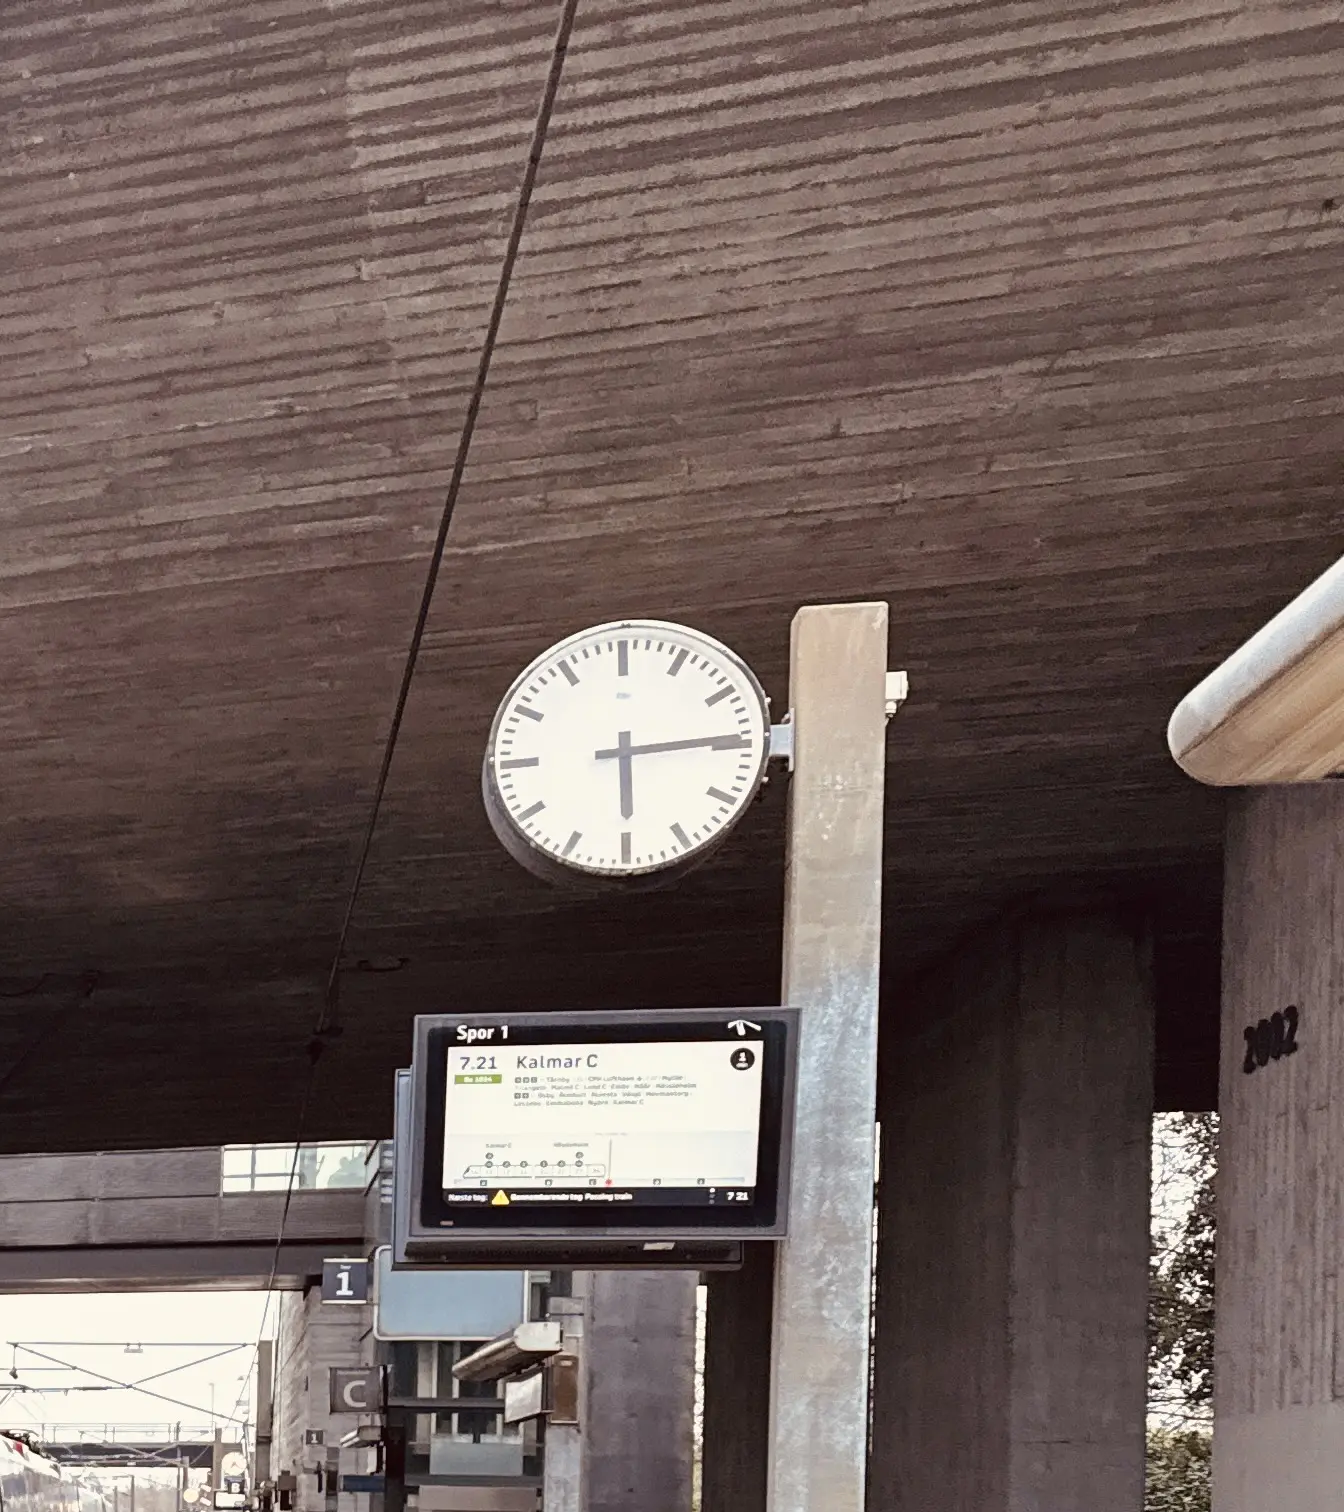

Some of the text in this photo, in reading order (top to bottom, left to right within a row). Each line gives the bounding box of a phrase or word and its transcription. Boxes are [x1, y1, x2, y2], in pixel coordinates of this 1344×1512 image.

[456, 1025, 509, 1043] Spor 1
[460, 1054, 599, 1070] 7.21 Kalmar C
[335, 1271, 354, 1296] 1
[343, 1380, 367, 1408] C
